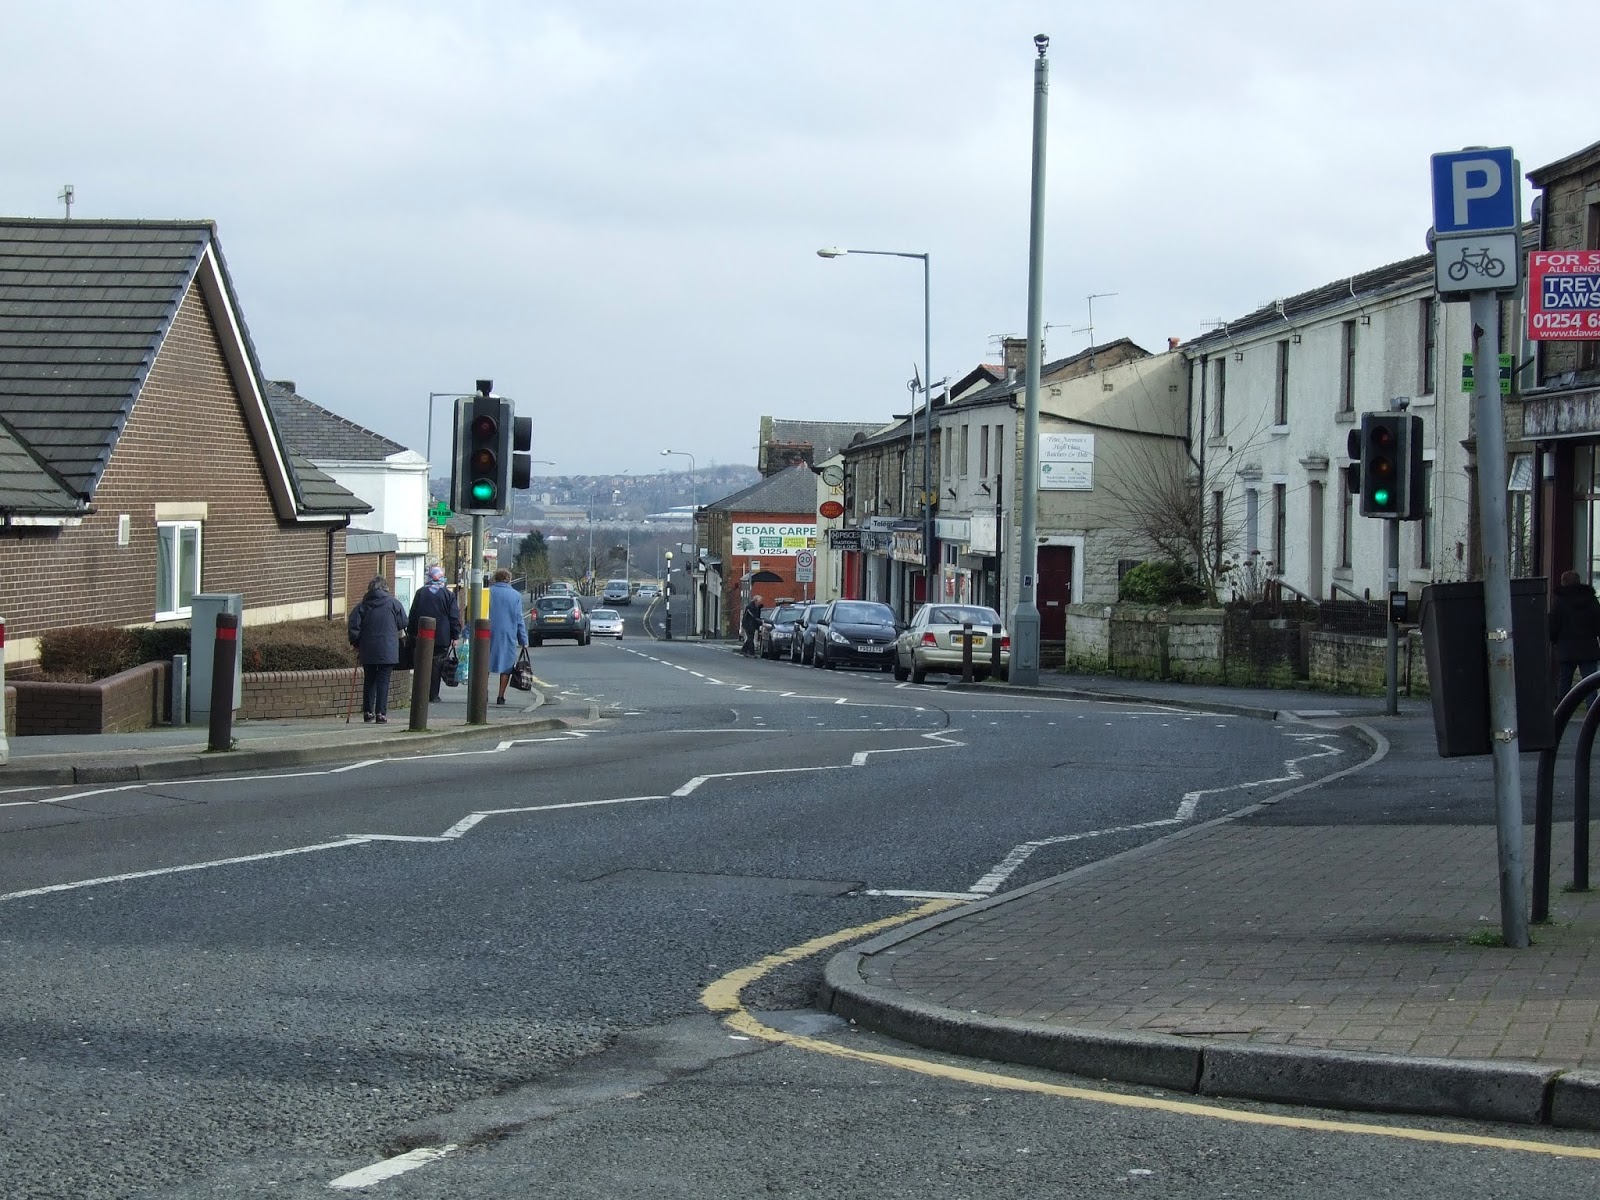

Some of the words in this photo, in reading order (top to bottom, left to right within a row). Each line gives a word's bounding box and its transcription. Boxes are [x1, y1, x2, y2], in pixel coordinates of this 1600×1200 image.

[1452, 159, 1501, 225] P
[1535, 254, 1579, 266] FOR
[1544, 277, 1600, 292] TREV
[1544, 292, 1600, 308] DAWS
[1533, 313, 1582, 329] 01254
[1587, 312, 1600, 328] 6
[736, 526, 776, 535] CEDAR
[779, 527, 816, 536] CARPE
